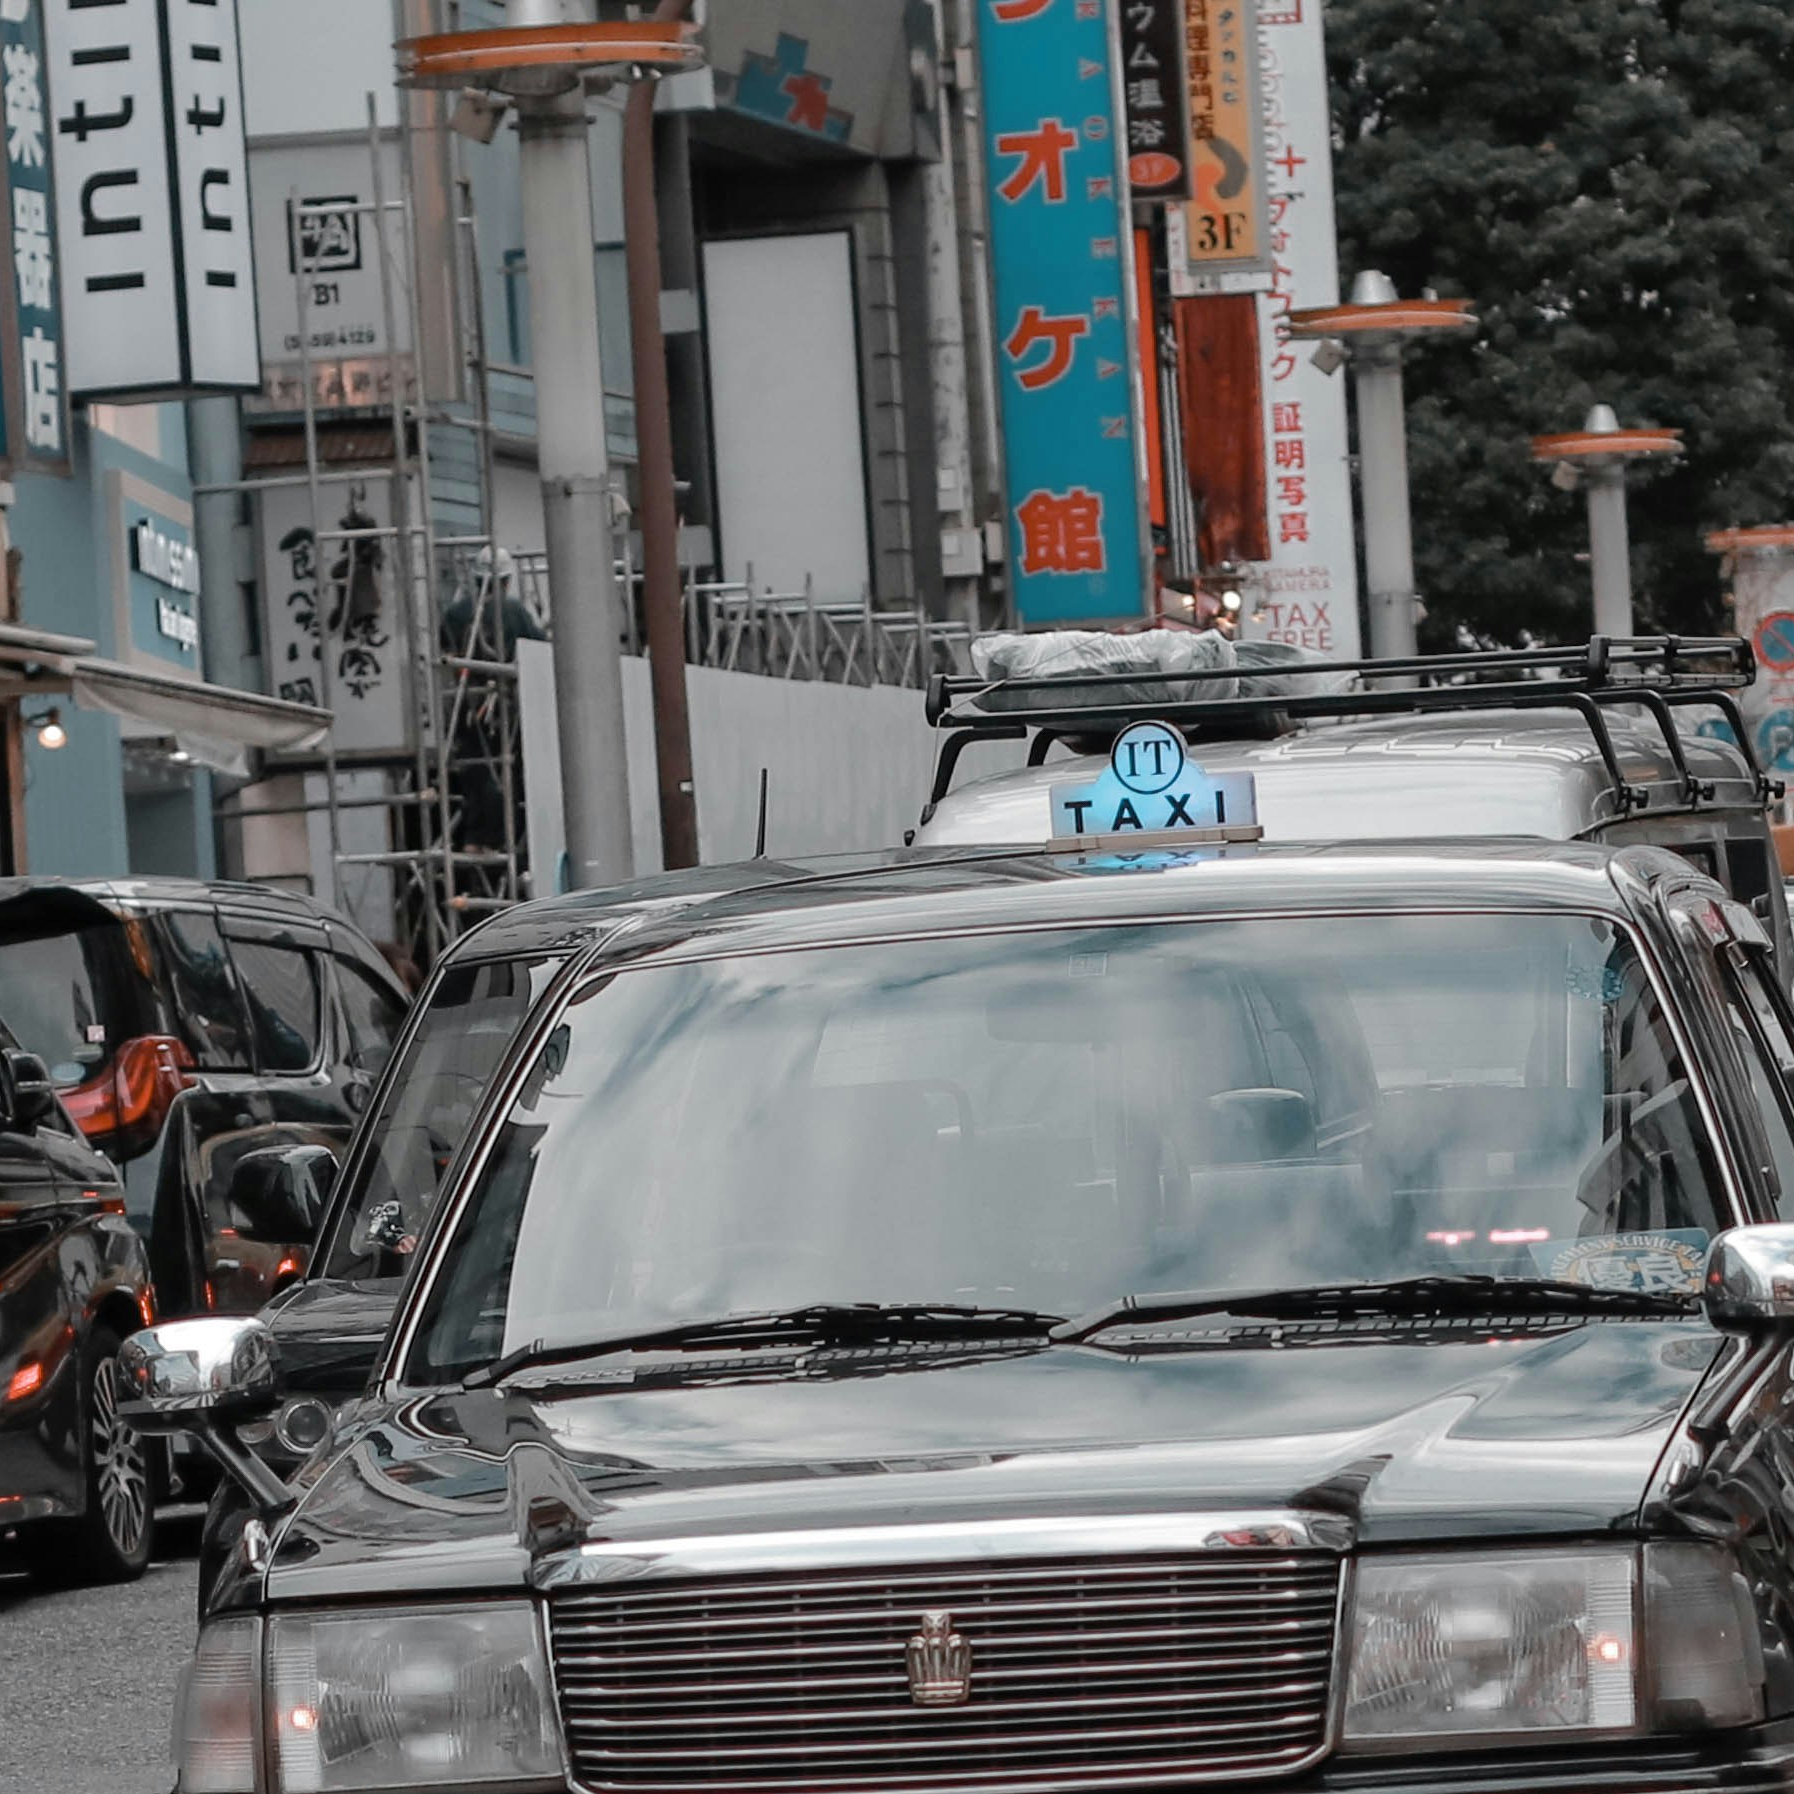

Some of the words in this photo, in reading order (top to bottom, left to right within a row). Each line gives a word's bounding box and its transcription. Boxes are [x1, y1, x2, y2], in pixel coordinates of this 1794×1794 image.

[1197, 211, 1246, 251] 3F
[312, 282, 340, 306] B1
[994, 0, 1105, 577] オケ館
[1272, 401, 1310, 543] 証明写真
[1264, 601, 1333, 628] TAX
[1124, 739, 1172, 778] IT
[1063, 790, 1227, 835] TAXI
[1611, 1234, 1680, 1251] SERVICE
[1579, 1254, 1695, 1294] 優良
